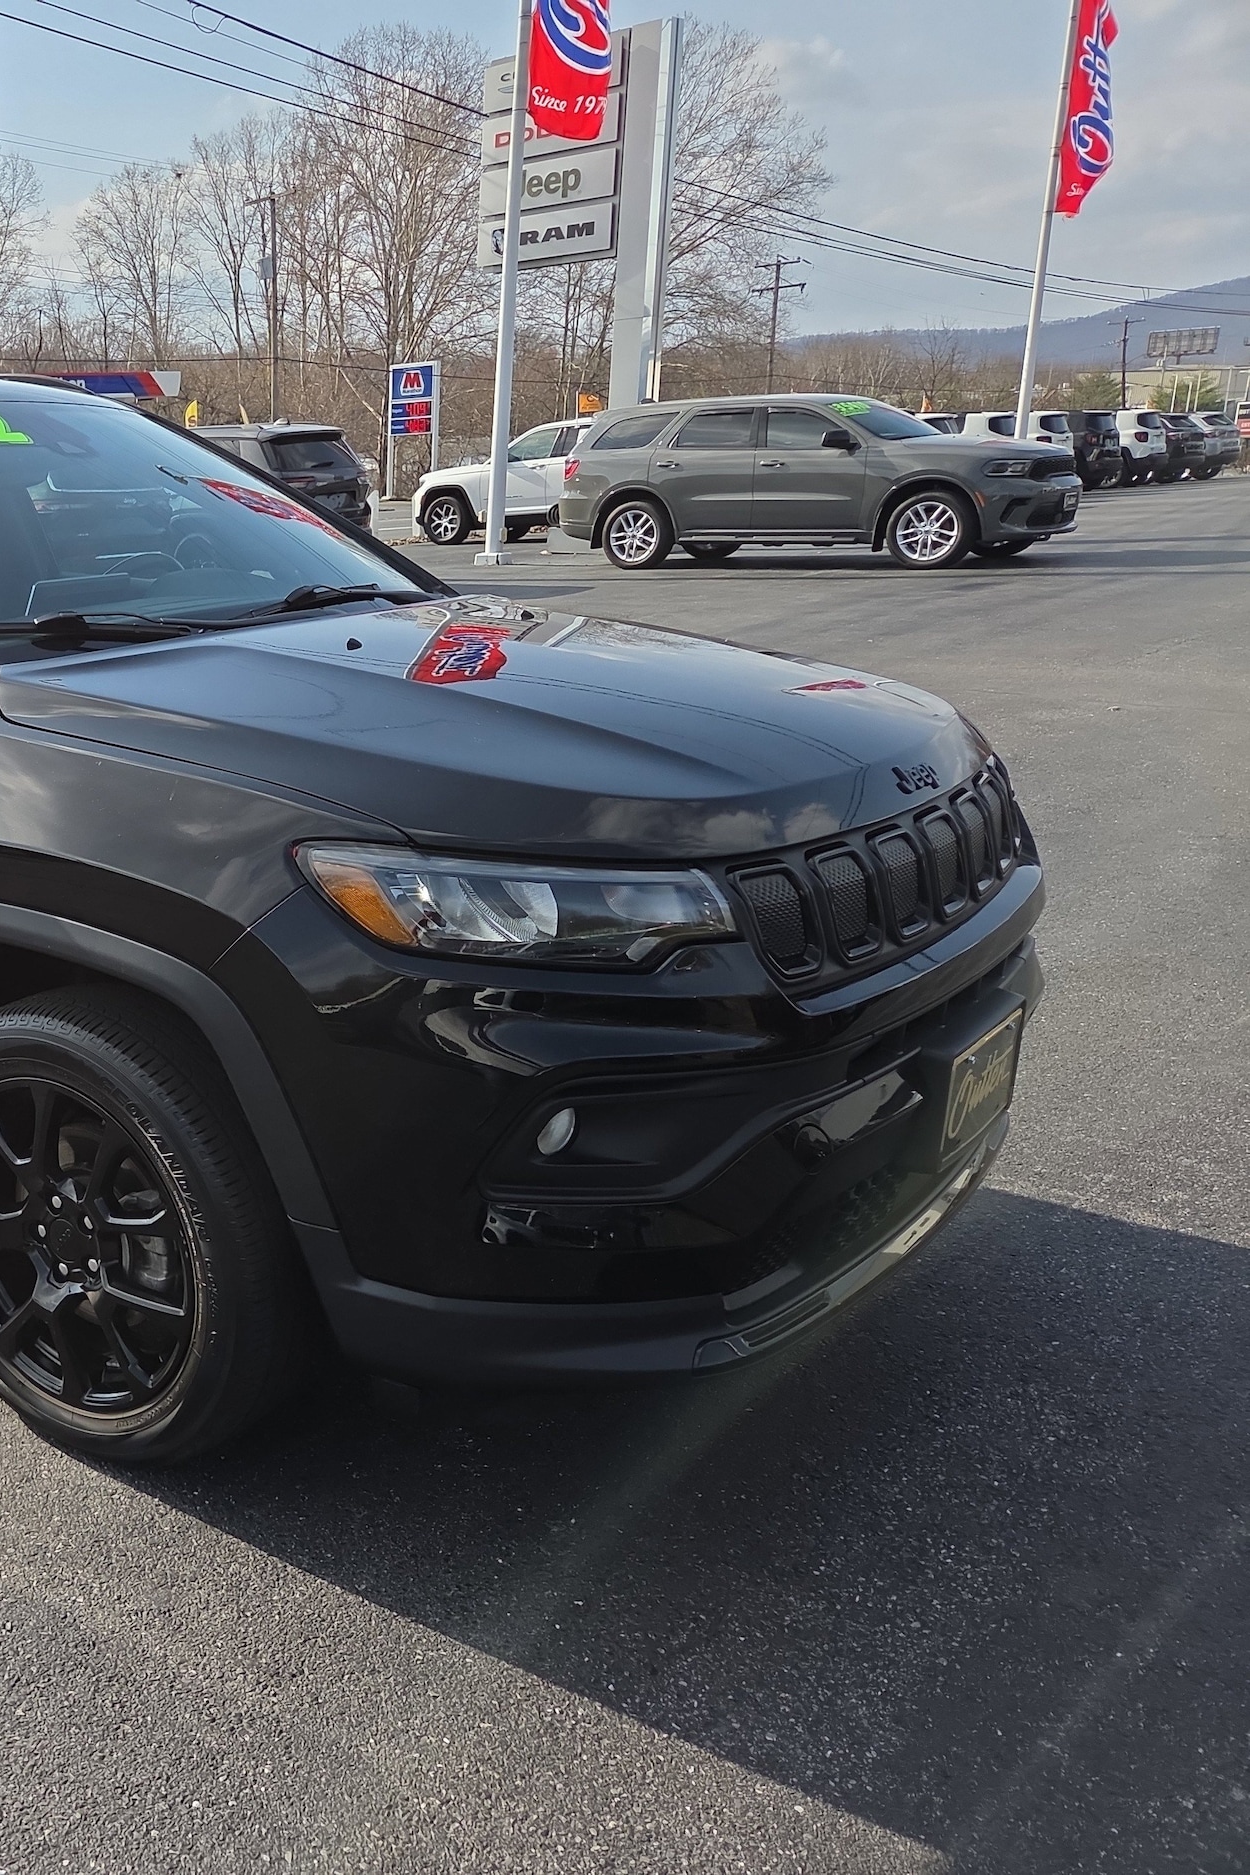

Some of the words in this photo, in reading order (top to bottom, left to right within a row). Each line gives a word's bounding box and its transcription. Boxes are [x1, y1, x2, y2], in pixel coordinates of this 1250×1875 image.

[531, 86, 567, 113] Since
[519, 221, 595, 246] RAM
[891, 764, 940, 795] Jeep
